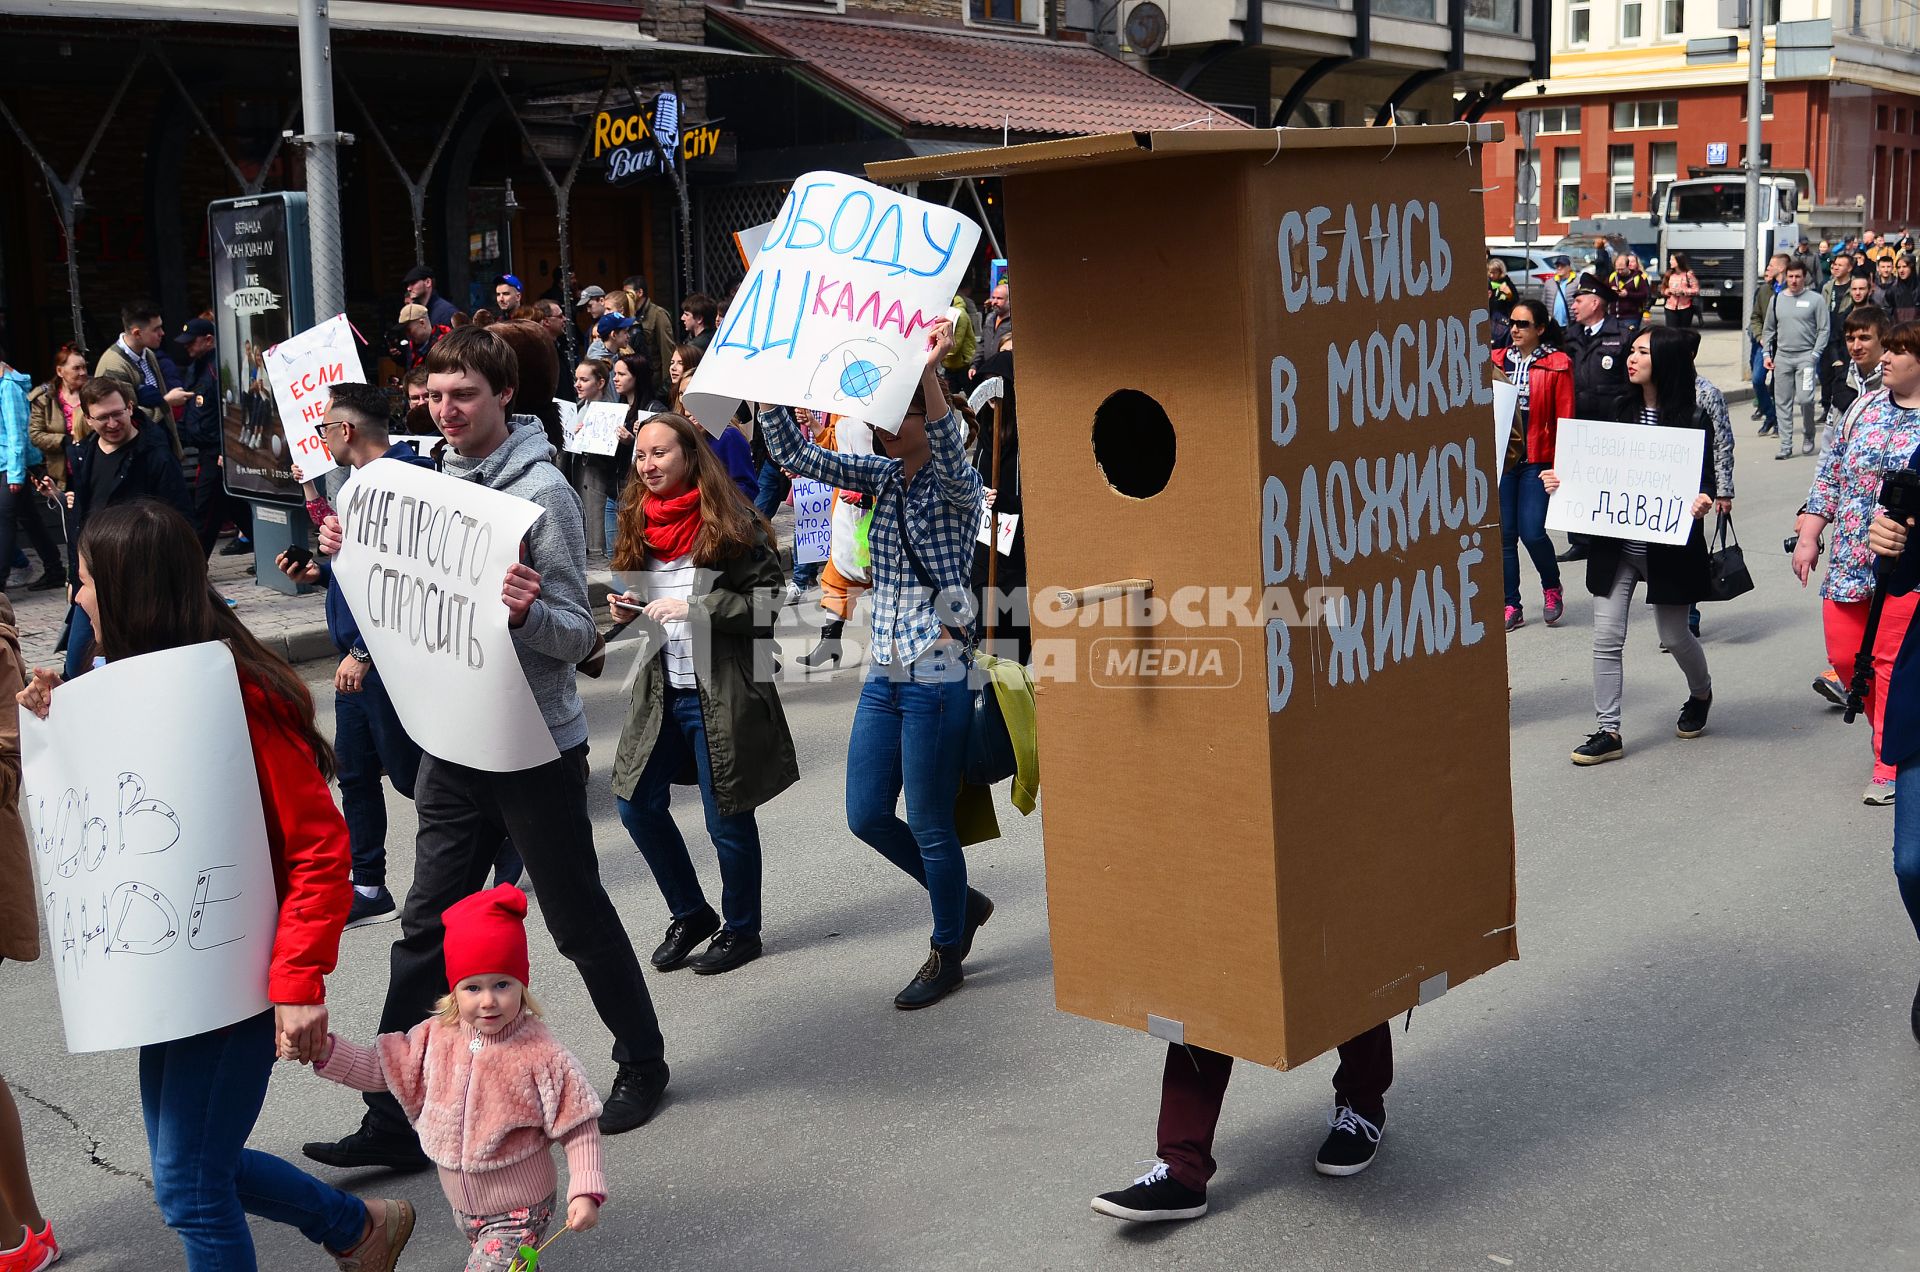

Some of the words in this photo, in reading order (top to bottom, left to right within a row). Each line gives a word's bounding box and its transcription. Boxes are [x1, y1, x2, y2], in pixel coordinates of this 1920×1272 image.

[1278, 200, 1452, 313] СЕЛИСЬ
[289, 363, 344, 400] ЕСЛИ
[1271, 355, 1297, 446] В
[1328, 308, 1494, 432] МОСКВЕ
[345, 484, 396, 553] МНЕ
[397, 495, 493, 587] ПРОСТО
[793, 481, 834, 498] НАСТО
[797, 530, 832, 546] ИНТРО
[1262, 437, 1488, 586] ВЛОЖИСЬ
[367, 563, 485, 670] СПРОСИТЬ
[1266, 618, 1294, 714] В
[1325, 532, 1485, 687] ЖИЛЬЁ
